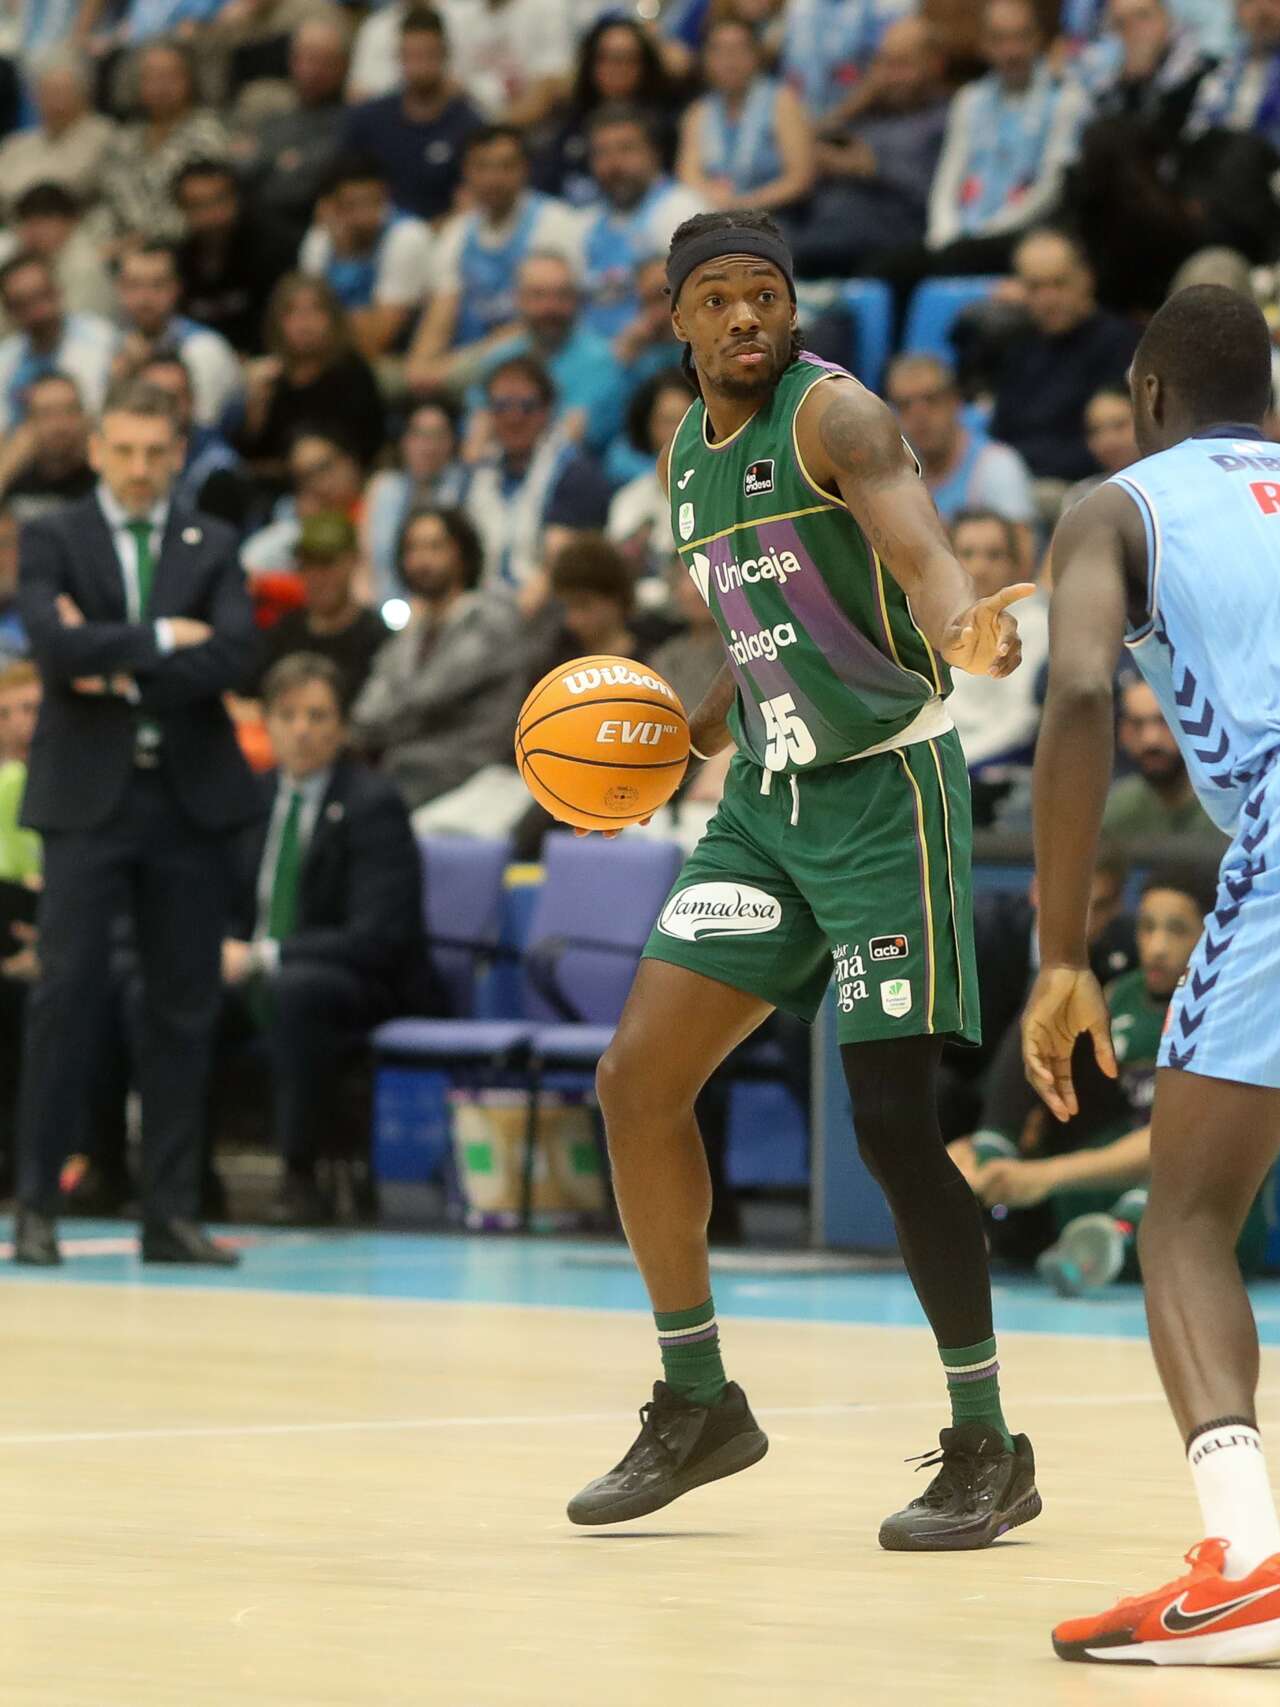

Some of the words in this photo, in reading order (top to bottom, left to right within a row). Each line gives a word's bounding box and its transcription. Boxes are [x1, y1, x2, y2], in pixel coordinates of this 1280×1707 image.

[714, 546, 802, 594] Unicaja
[562, 666, 674, 700] Wilson
[596, 720, 663, 745] EVO
[759, 693, 817, 772] 55
[662, 888, 776, 925] famadesa
[874, 945, 900, 957] acb
